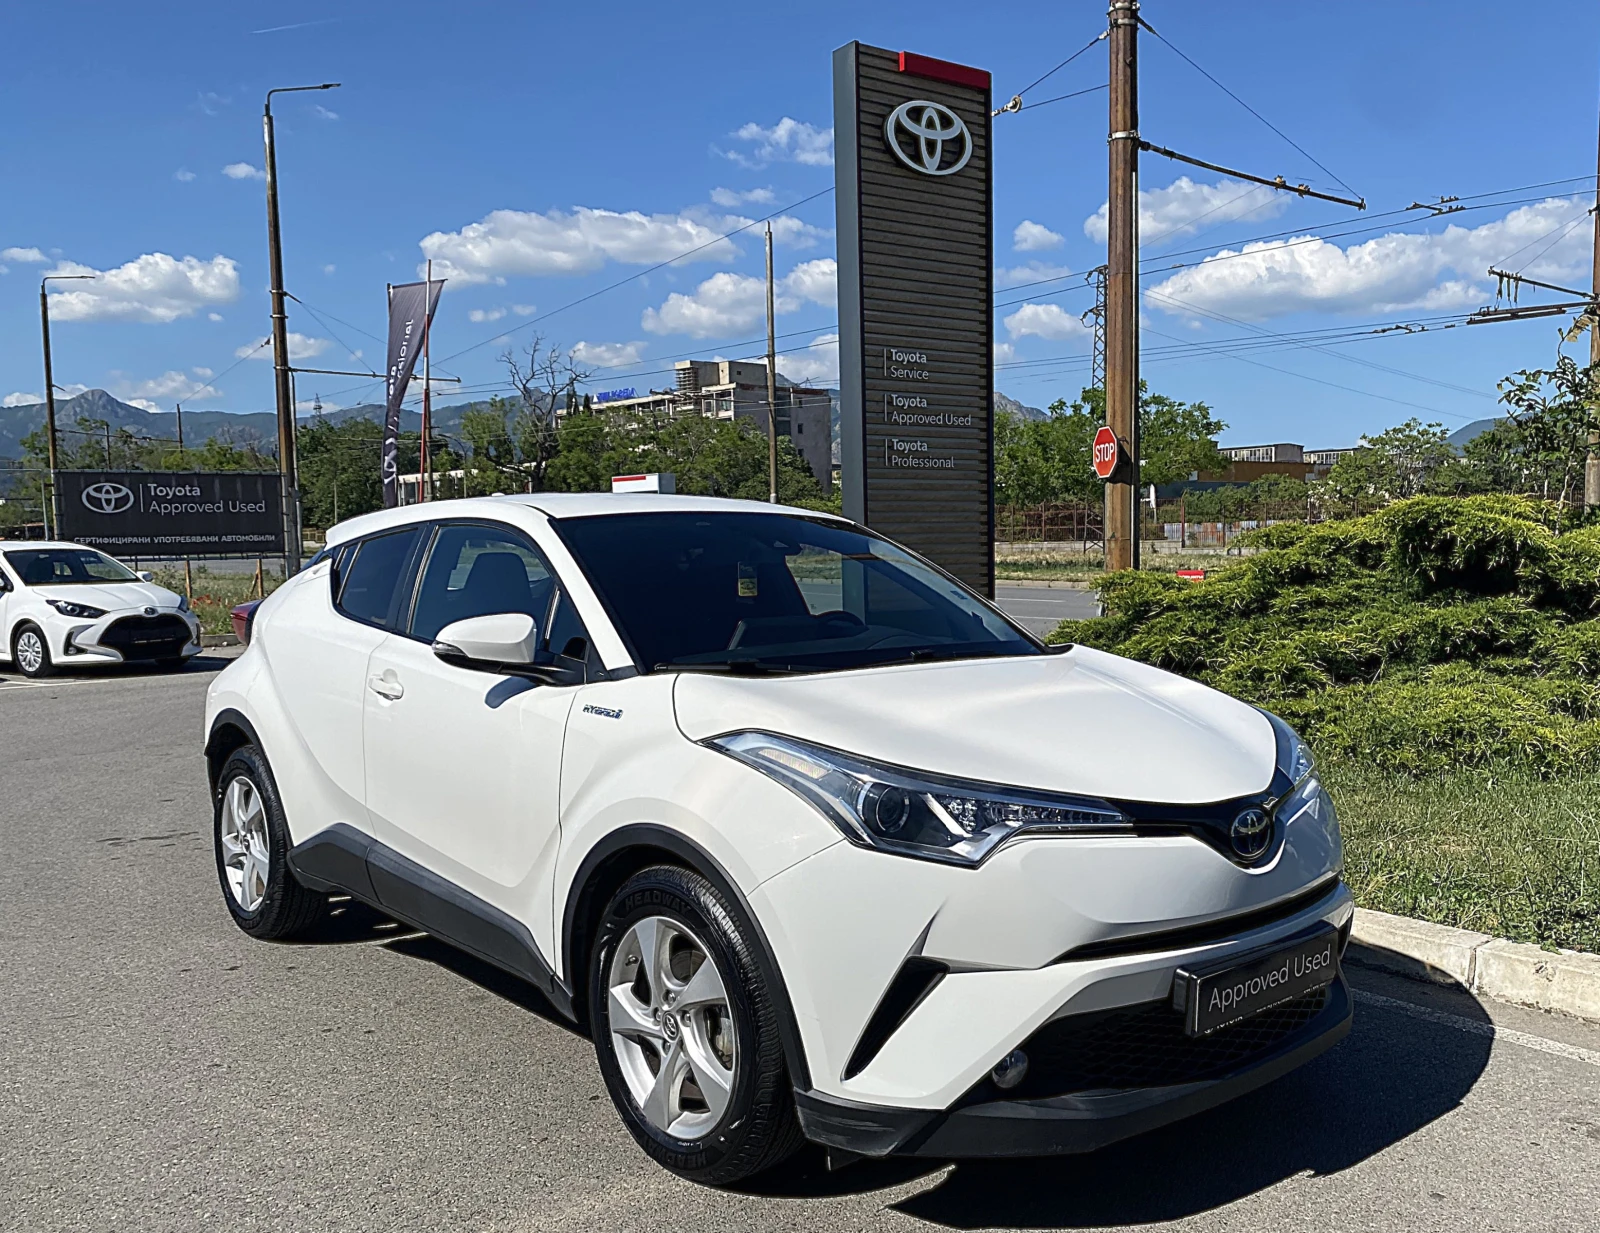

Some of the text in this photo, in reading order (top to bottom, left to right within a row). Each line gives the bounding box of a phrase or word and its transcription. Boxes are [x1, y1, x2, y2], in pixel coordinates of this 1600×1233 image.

[890, 349, 927, 364] Toyota
[890, 366, 929, 380] Service
[891, 394, 927, 409] Toyota
[891, 411, 971, 426] Approved Used
[892, 439, 928, 453] Toyota
[1095, 443, 1115, 462] STOP
[892, 455, 954, 468] Professional
[148, 484, 201, 499] Toyota
[149, 500, 266, 515] Approved Used
[74, 534, 275, 545] СЕРТИФИЦИРАНИ УПОТРЕБЯВАНИ АВТОМОБИЛИ
[625, 890, 692, 914] HEADWAY
[1208, 959, 1289, 1013] Approved
[1294, 943, 1331, 978] Used
